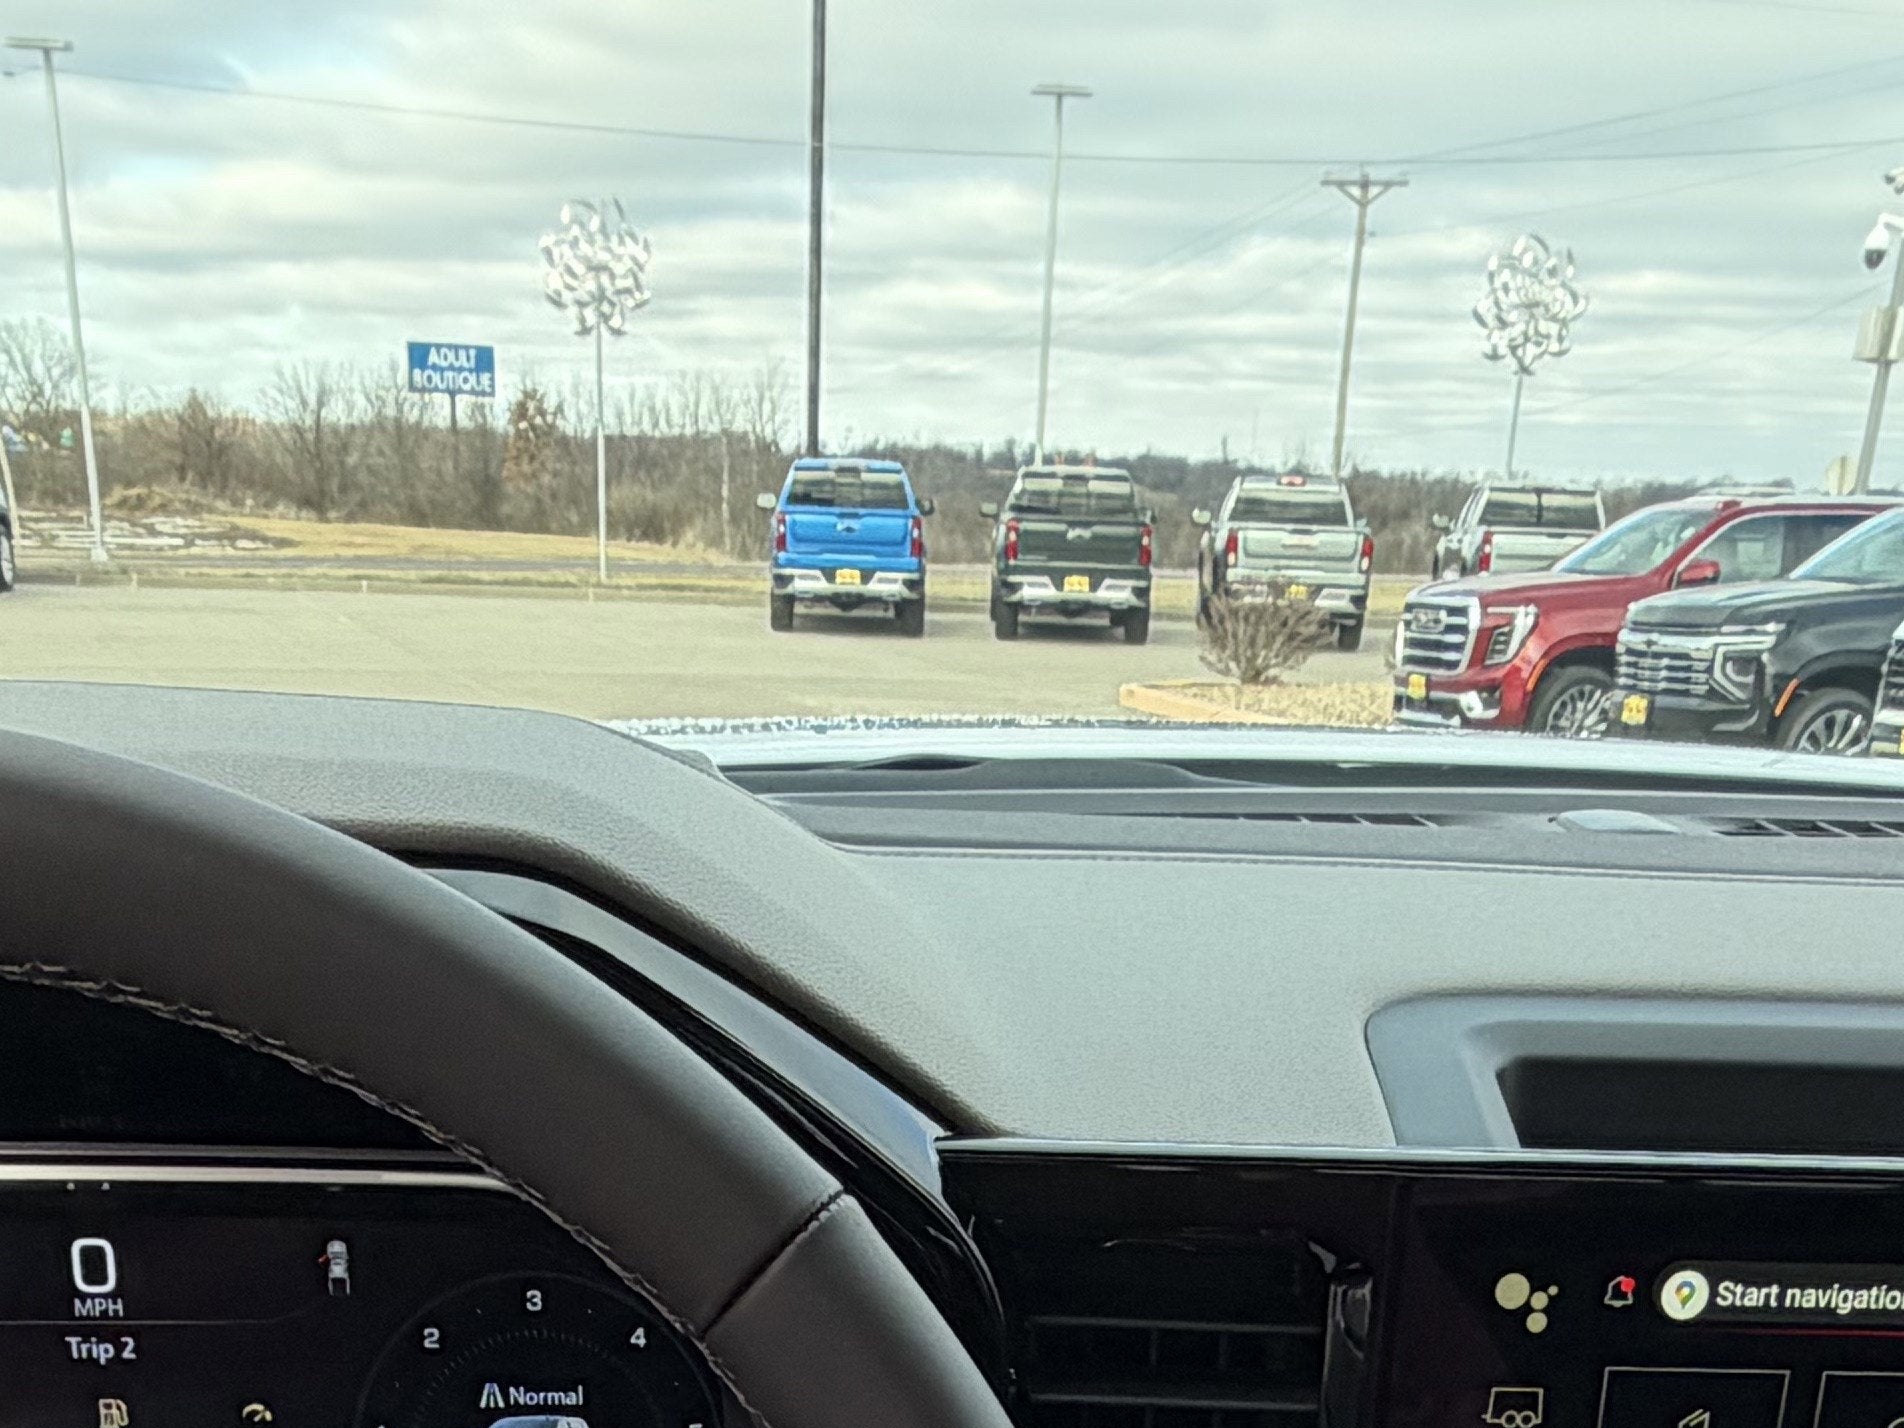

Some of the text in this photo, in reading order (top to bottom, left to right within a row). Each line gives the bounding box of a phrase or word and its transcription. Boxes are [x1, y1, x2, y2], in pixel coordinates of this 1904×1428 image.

[427, 346, 477, 369] ADULT
[412, 368, 492, 393] BOUTIQUE
[70, 1238, 116, 1294] 0
[526, 1290, 542, 1312] 3
[1715, 1281, 1778, 1308] Start
[73, 1298, 124, 1318] MPH
[423, 1328, 440, 1350] 2
[629, 1327, 647, 1348] 4
[65, 1336, 137, 1365] Trip 2
[508, 1384, 584, 1407] Normal
